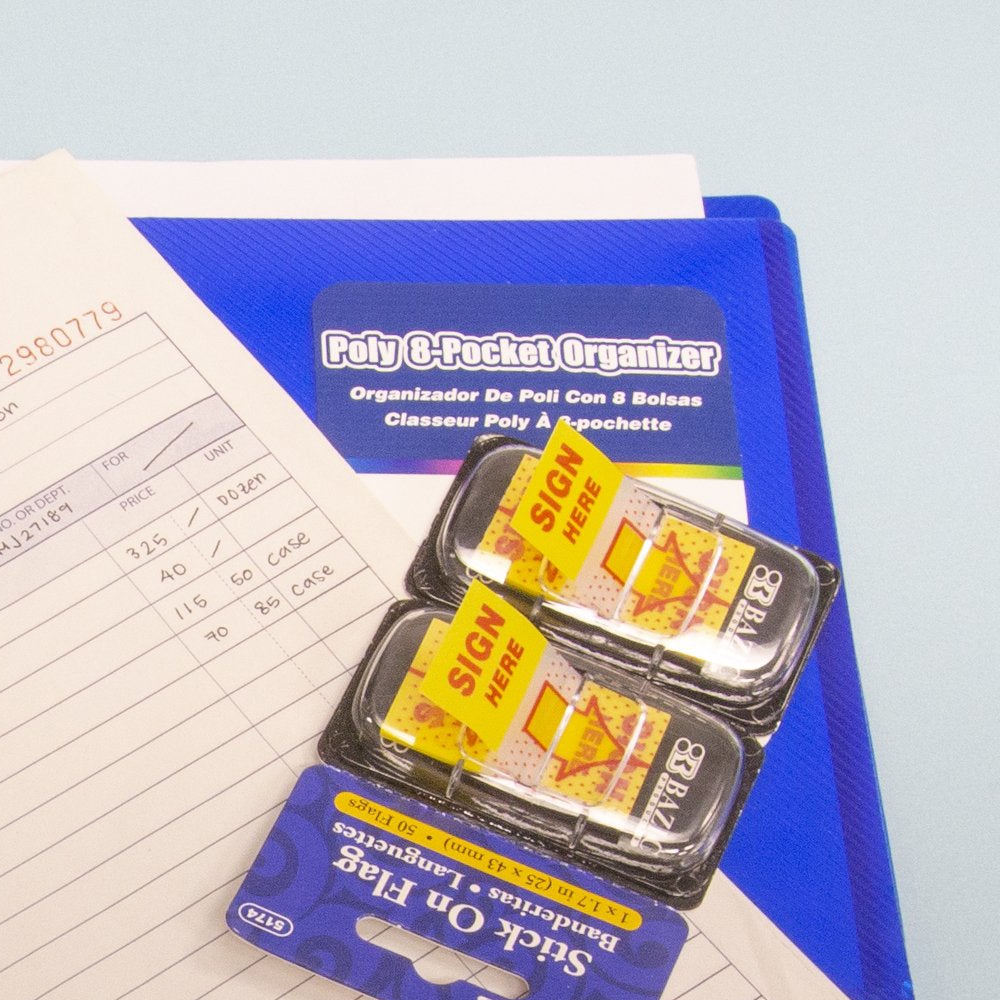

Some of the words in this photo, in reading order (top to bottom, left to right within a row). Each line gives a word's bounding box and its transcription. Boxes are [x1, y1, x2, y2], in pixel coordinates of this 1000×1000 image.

[322, 329, 403, 372] Poly
[404, 330, 558, 373] 8-Pocket
[557, 333, 721, 378] Organizer
[349, 386, 479, 406] Organizador
[484, 387, 514, 403] De
[518, 387, 560, 404] Poli
[565, 389, 607, 405] Con
[612, 390, 627, 405] 8
[631, 391, 703, 408] Bolsas
[384, 411, 479, 428] Classeur
[484, 412, 531, 431] Poly
[100, 450, 130, 472] FOR
[203, 439, 235, 464] UNIT
[34, 485, 71, 511] DEPT.
[118, 486, 156, 513] PRICE
[530, 442, 584, 533] SIGN
[561, 475, 602, 545] HERE
[126, 532, 168, 560] 325
[160, 562, 187, 583] 40
[230, 568, 253, 587] 50
[174, 593, 208, 620] 115
[254, 595, 281, 616] 85
[447, 602, 507, 697] SIGN
[484, 637, 526, 709] HERE
[348, 798, 395, 827] Flags
[397, 820, 418, 836] 50
[332, 821, 466, 890] Languettes
[443, 836, 484, 862] mm)
[332, 844, 418, 908] Flag
[487, 857, 507, 873] 43
[526, 874, 552, 891] (25
[425, 888, 485, 934] On
[577, 894, 600, 913] 1.7
[246, 907, 286, 932] 5174
[487, 886, 621, 954] Banderitas
[494, 917, 593, 977] Stick
